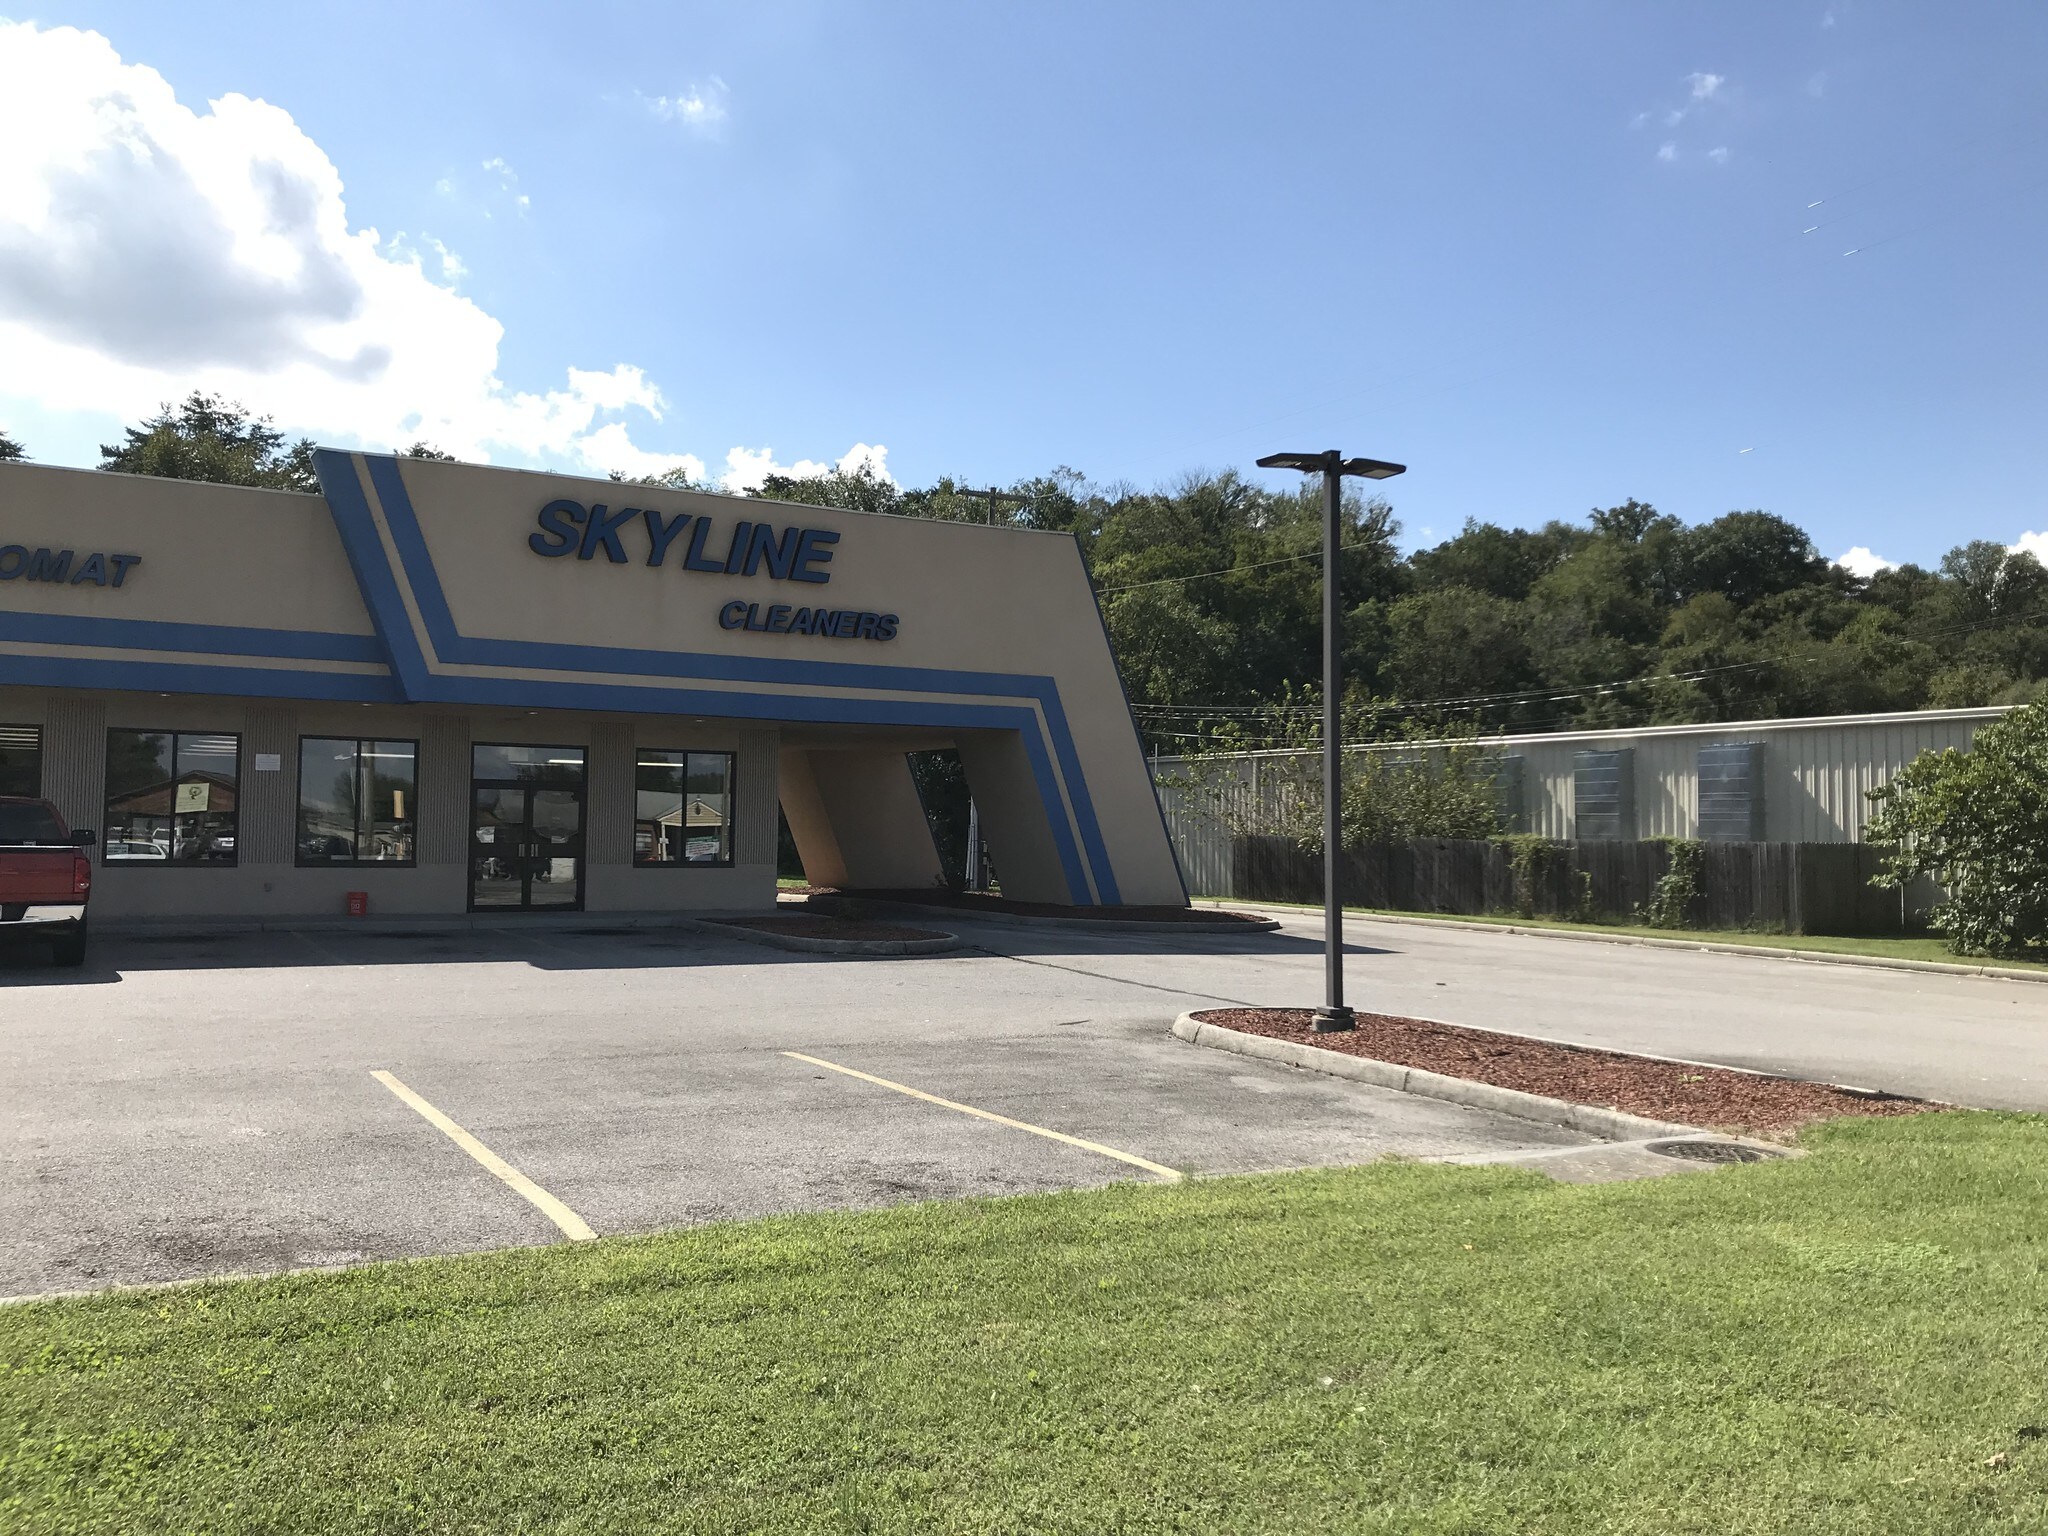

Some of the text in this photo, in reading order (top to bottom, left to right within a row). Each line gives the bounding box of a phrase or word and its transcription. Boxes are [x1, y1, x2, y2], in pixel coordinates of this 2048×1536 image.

[528, 499, 841, 583] SKYLINE
[0, 545, 142, 588] OMAT
[719, 600, 900, 641] CLEANERS
